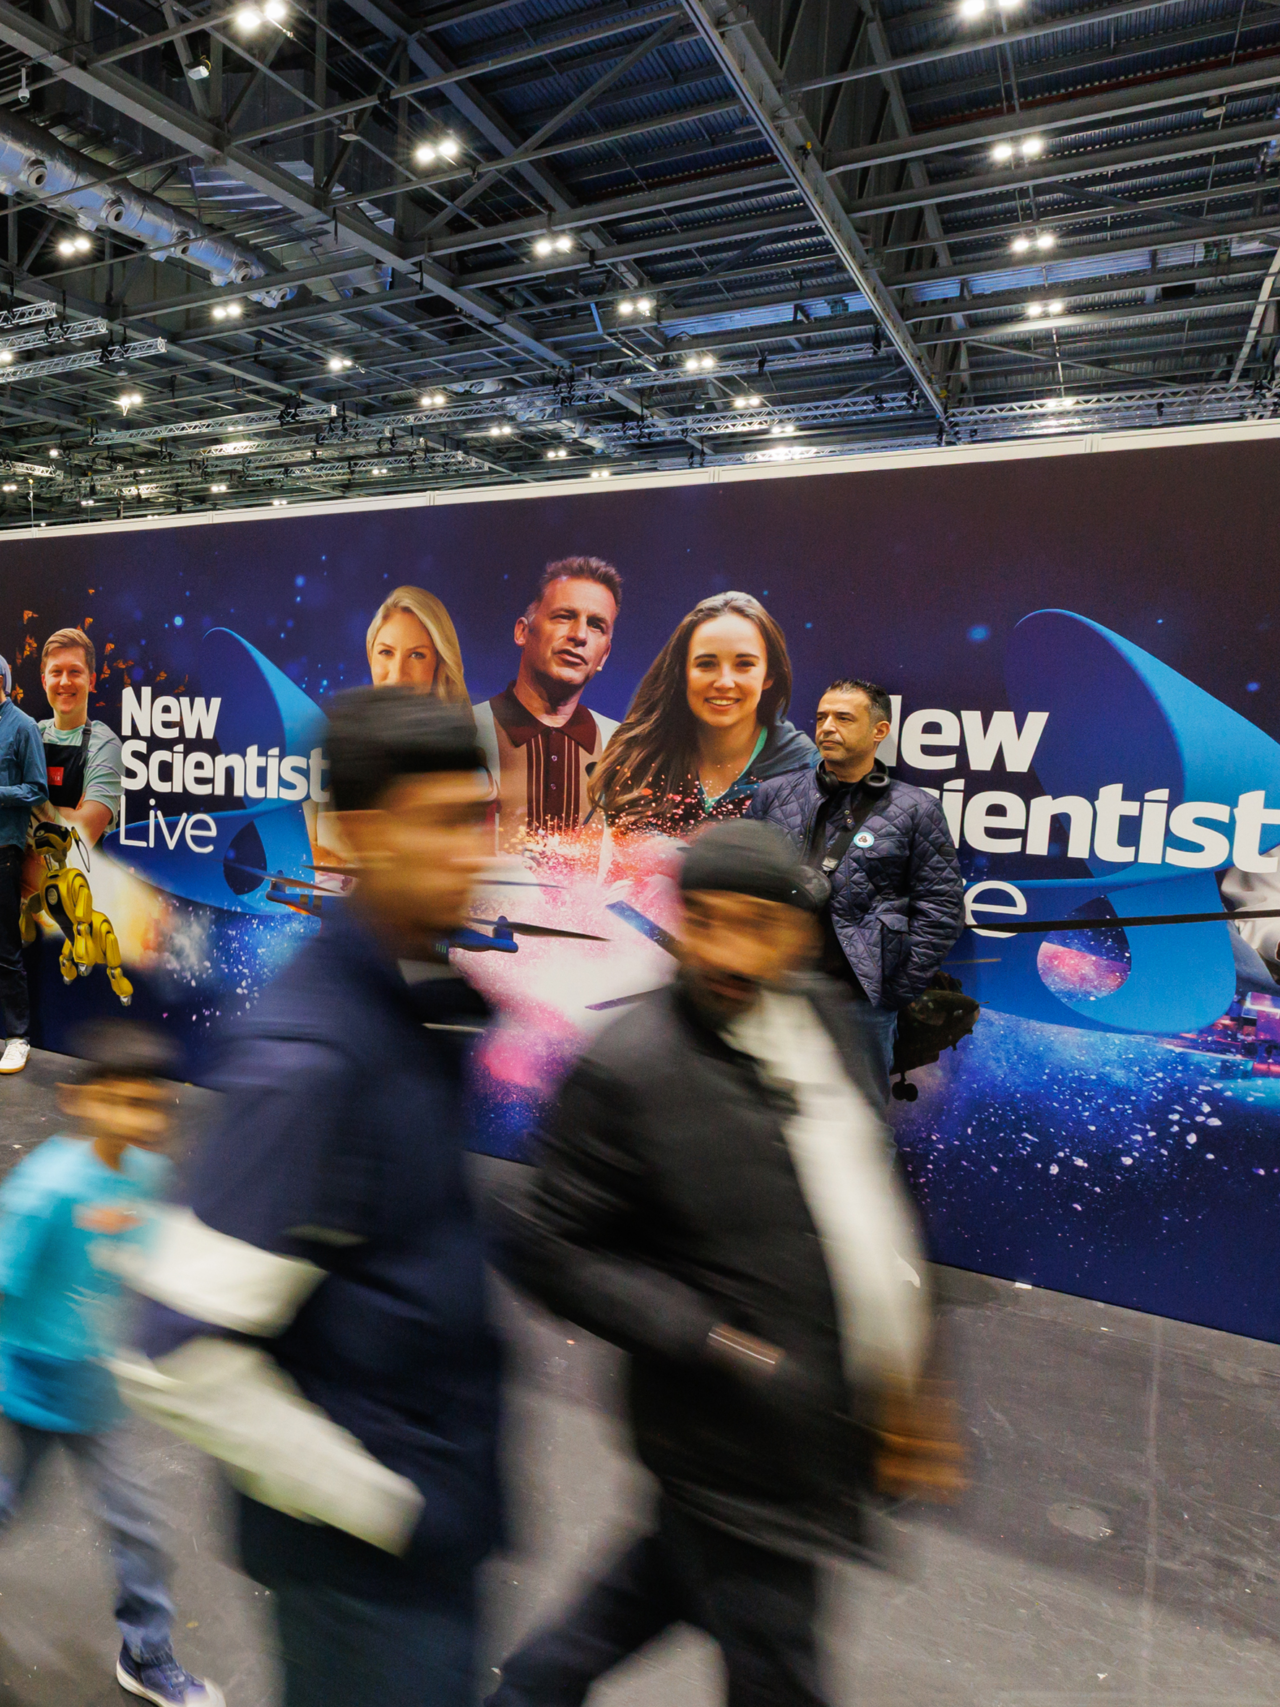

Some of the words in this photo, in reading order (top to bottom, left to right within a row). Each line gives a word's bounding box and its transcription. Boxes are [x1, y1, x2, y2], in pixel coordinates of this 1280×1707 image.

[121, 686, 222, 740] New
[120, 739, 332, 803] Scientist
[119, 794, 218, 854] Live
[918, 778, 1280, 874] ientist
